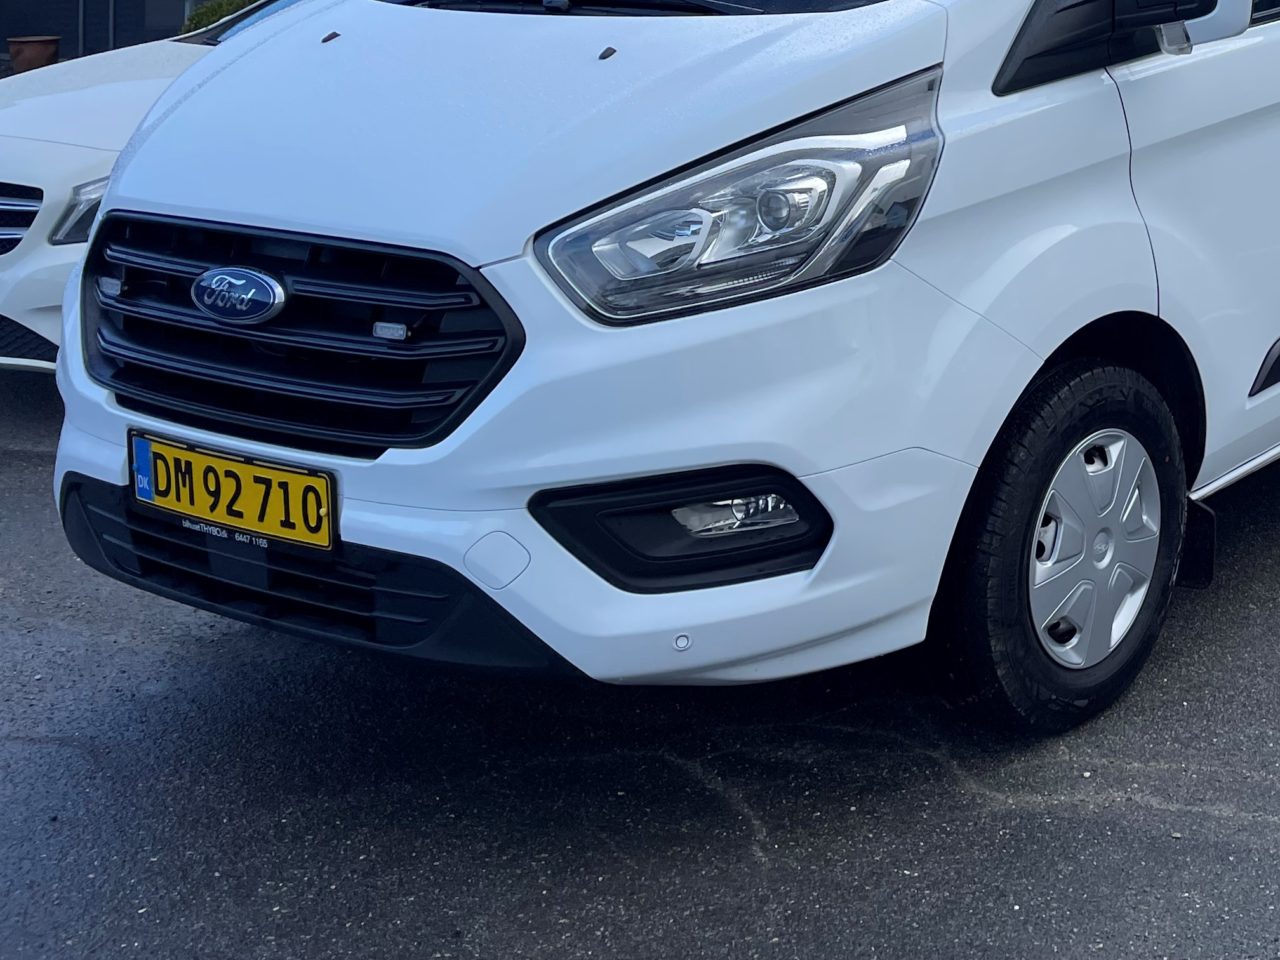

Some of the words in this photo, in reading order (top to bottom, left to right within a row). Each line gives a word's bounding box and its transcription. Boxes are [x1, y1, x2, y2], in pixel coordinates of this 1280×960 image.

[204, 275, 256, 311] Ford
[138, 474, 150, 491] DK
[152, 451, 194, 506] DM
[203, 465, 244, 519] 92
[253, 475, 323, 534] 710
